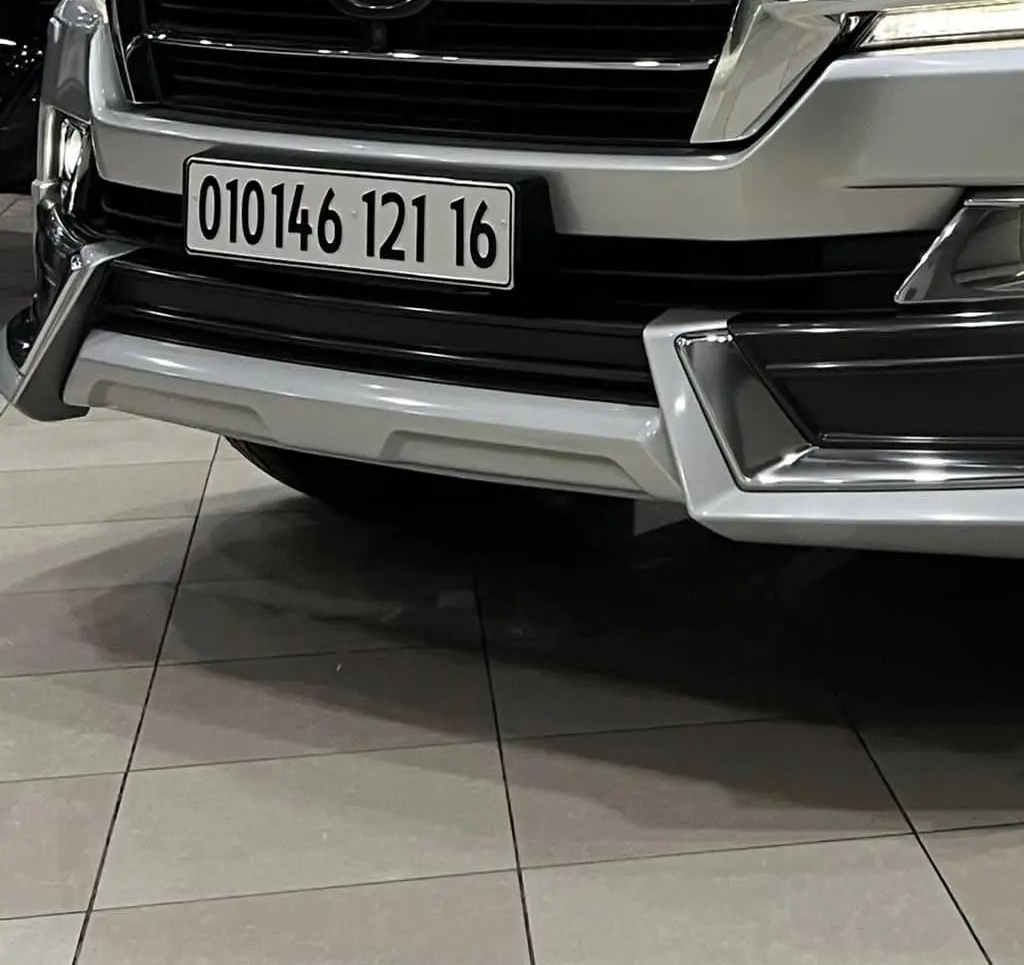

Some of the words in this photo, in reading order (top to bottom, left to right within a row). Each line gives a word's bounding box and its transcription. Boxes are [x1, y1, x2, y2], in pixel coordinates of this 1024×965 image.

[199, 175, 342, 254] 010146
[361, 189, 427, 262] 121
[450, 197, 497, 269] 16
